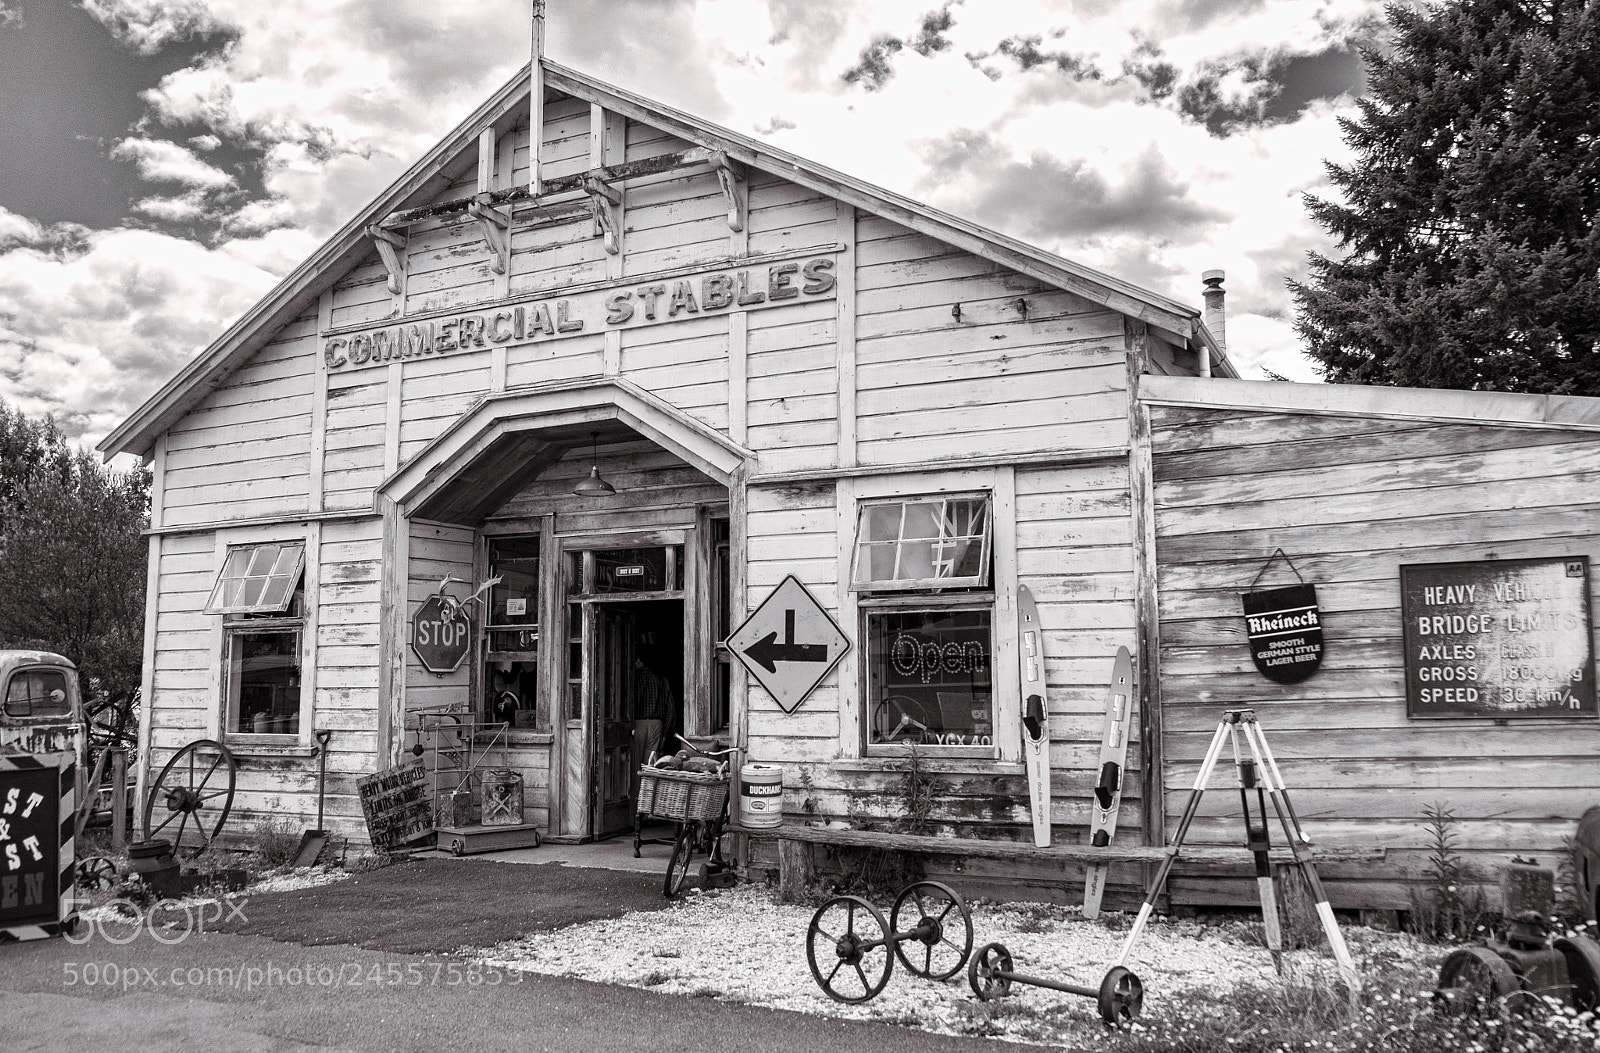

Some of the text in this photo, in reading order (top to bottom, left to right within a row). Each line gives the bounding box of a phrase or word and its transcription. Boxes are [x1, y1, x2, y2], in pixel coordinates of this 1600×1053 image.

[324, 258, 835, 368] COMMERCIAL STABLES
[1424, 584, 1476, 606] HEAVY
[1247, 610, 1319, 633] Rheineck
[1418, 610, 1578, 635] BRIDGE LIMITS
[418, 619, 466, 647] STOP
[1257, 644, 1321, 660] GERMAN STYLE
[1268, 637, 1305, 650] SMOOTH
[1418, 645, 1476, 661] AXLES
[891, 634, 985, 684] Open
[1266, 653, 1317, 667] LAGER BEER
[1418, 666, 1479, 682] GROSS
[1420, 688, 1478, 703] SPEED
